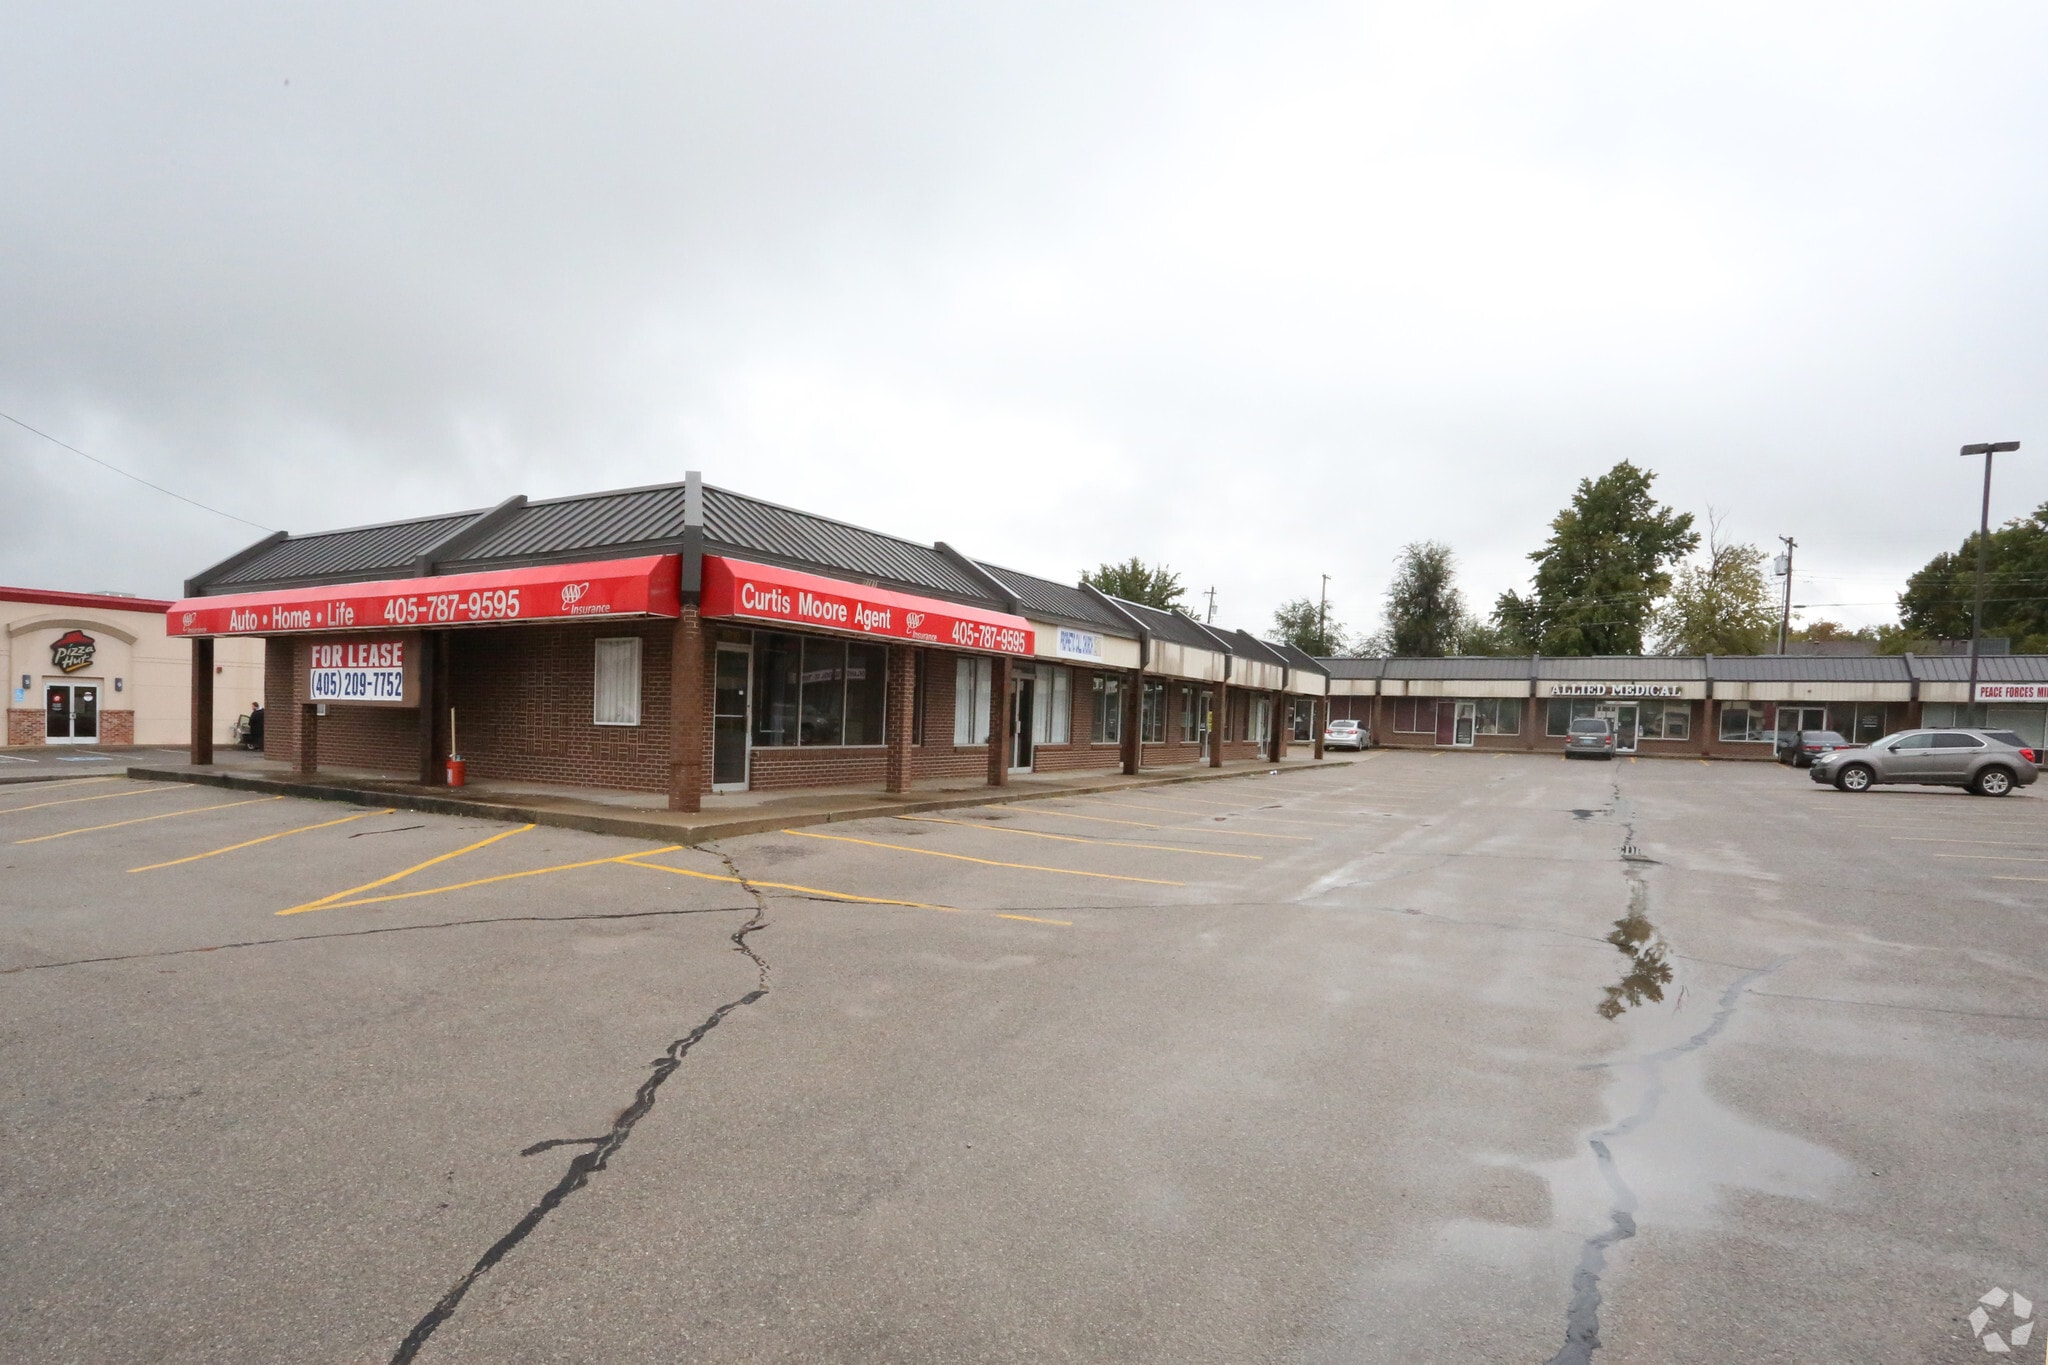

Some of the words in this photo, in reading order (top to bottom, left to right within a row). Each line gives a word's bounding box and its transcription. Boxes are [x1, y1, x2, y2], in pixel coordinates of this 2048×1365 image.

[562, 584, 581, 603] AAA
[229, 609, 258, 631] Auto
[272, 606, 311, 629] Home
[327, 602, 354, 626] Life
[383, 589, 520, 623] 405-787-9595
[571, 604, 611, 614] Insurance
[741, 582, 791, 614] Curtis
[798, 592, 848, 622] Moore
[854, 602, 892, 631] Agent
[952, 620, 1026, 653] 405-787-9595
[54, 643, 94, 664] Pizza
[62, 654, 90, 668] Hut
[312, 645, 342, 668] FOR
[348, 642, 403, 667] LEASE
[312, 670, 342, 698] (405)
[345, 672, 402, 697] 209-7752
[1551, 684, 1606, 696] ALLIED
[1611, 684, 1682, 697] MEDICAL
[1980, 686, 2002, 697] PEACE
[2006, 686, 2034, 698] FORCES
